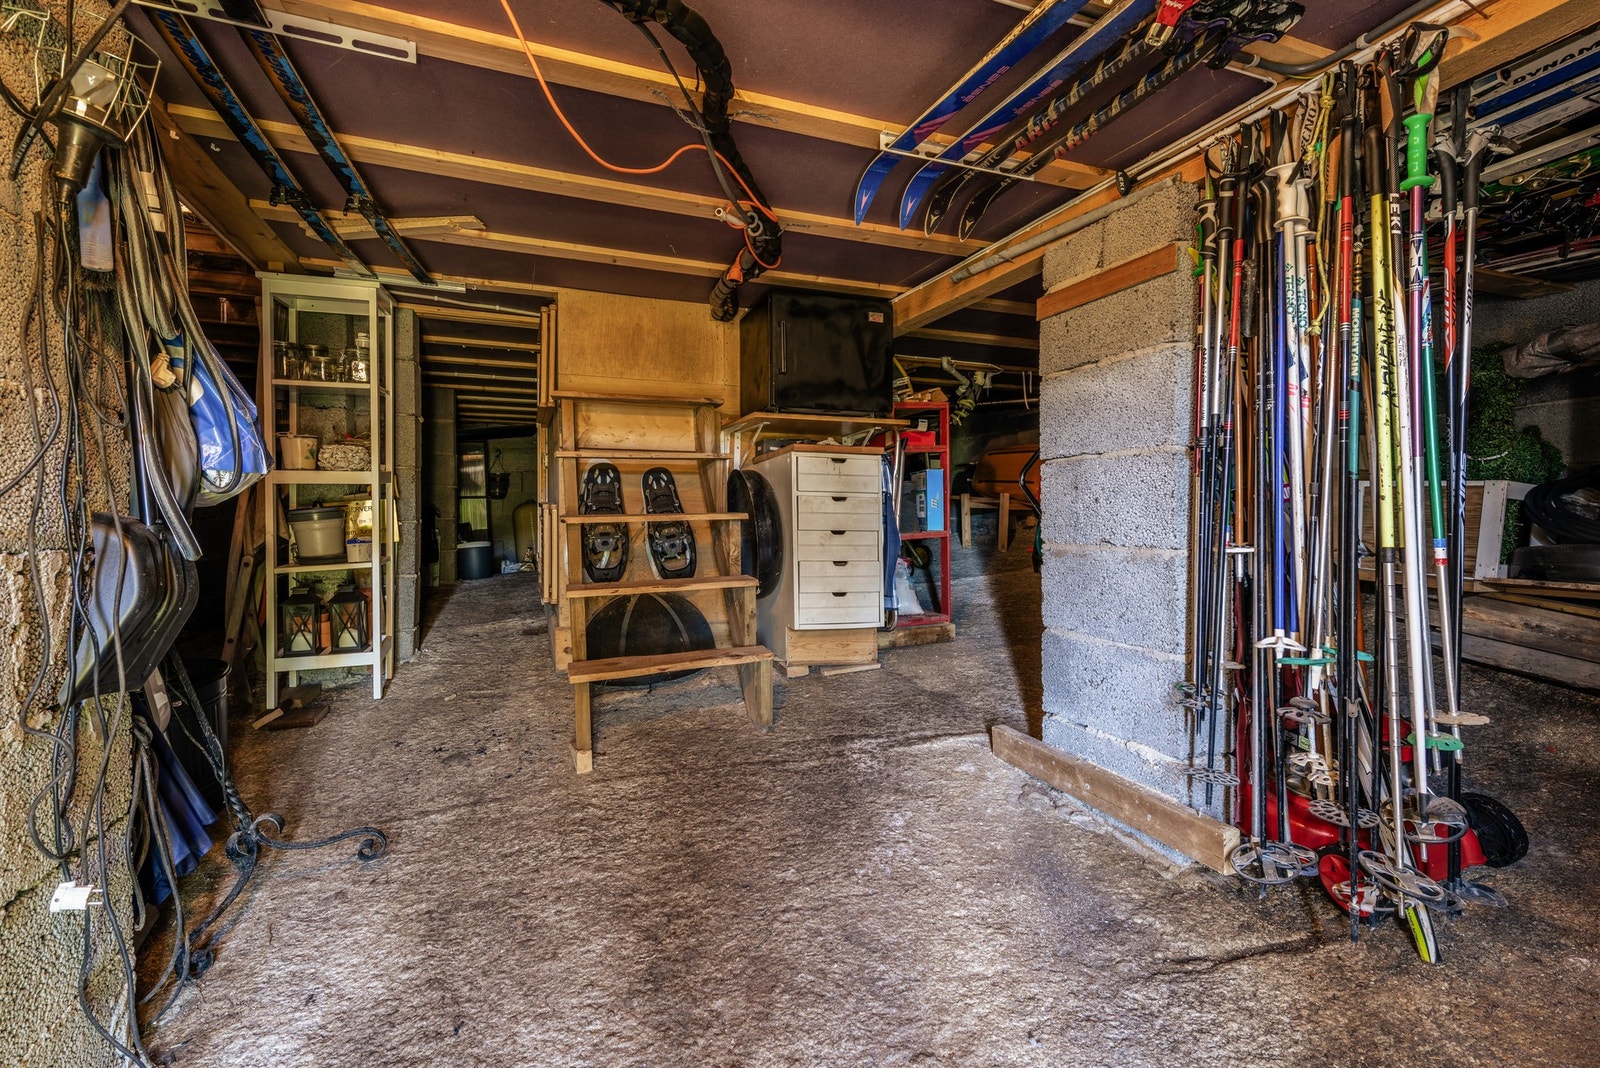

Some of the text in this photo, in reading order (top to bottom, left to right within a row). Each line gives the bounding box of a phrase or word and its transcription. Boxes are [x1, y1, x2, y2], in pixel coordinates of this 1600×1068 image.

[964, 153, 1000, 182] ATMIC
[999, 162, 1038, 189] ATMIC
[1389, 193, 1401, 235] LEKI
[1353, 255, 1362, 293] SWIX
[1285, 275, 1296, 315] TECNO
[1297, 288, 1308, 329] TECNO
[1465, 272, 1473, 328] SWIX
[1351, 306, 1361, 377] MOUNTAIN
[1458, 453, 1467, 523] SWIX
